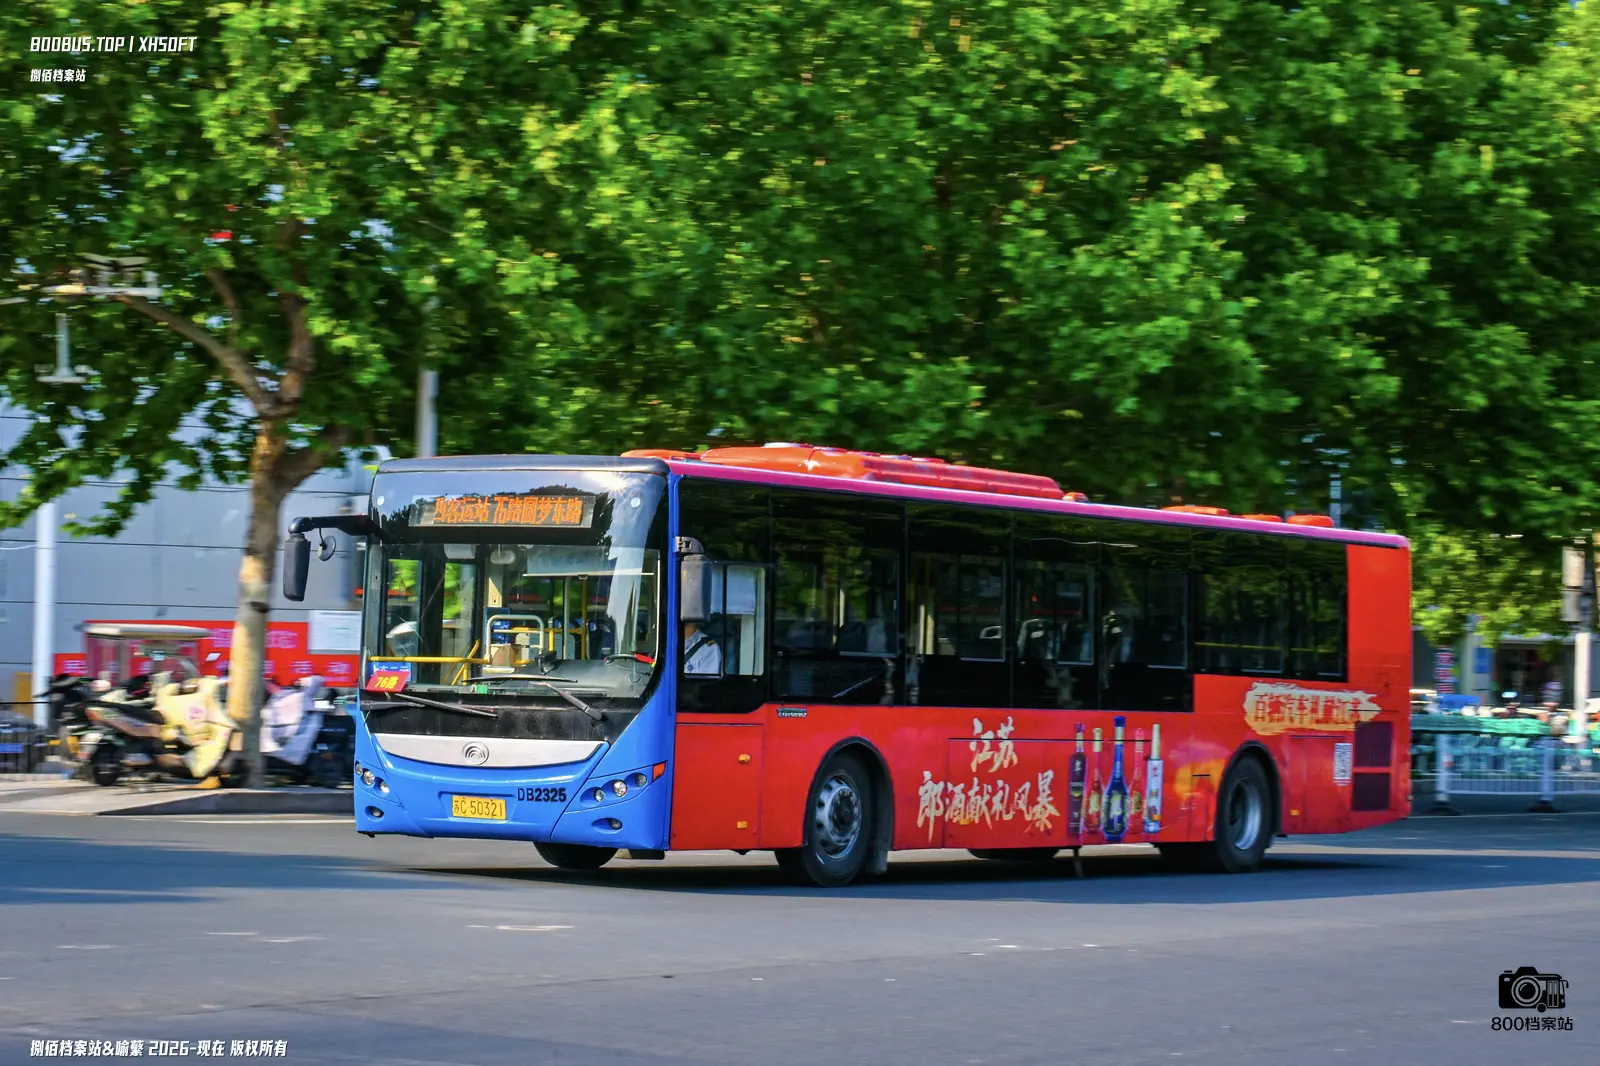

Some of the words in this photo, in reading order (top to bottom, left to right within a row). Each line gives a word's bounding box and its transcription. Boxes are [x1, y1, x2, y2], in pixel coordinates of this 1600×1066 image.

[374, 675, 399, 690] 76路
[969, 716, 1018, 773] 江苏
[517, 787, 567, 803] DB2325
[916, 769, 1061, 844] 郎酒献礼风暴
